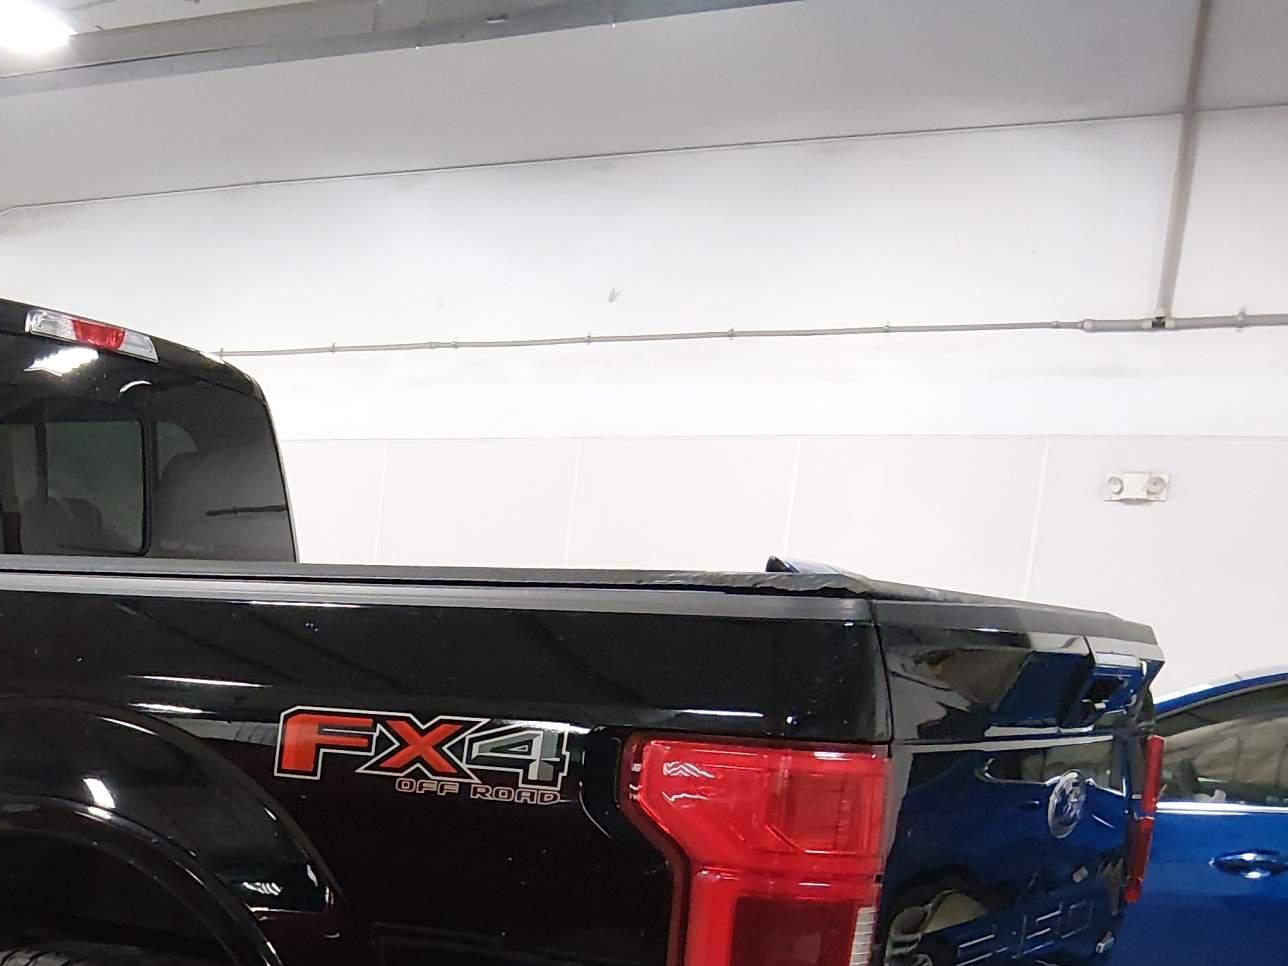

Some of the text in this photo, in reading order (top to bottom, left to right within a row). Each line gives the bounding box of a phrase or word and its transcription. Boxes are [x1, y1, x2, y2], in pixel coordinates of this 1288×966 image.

[274, 706, 570, 790] FX4
[395, 777, 561, 806] OFF ROAD
